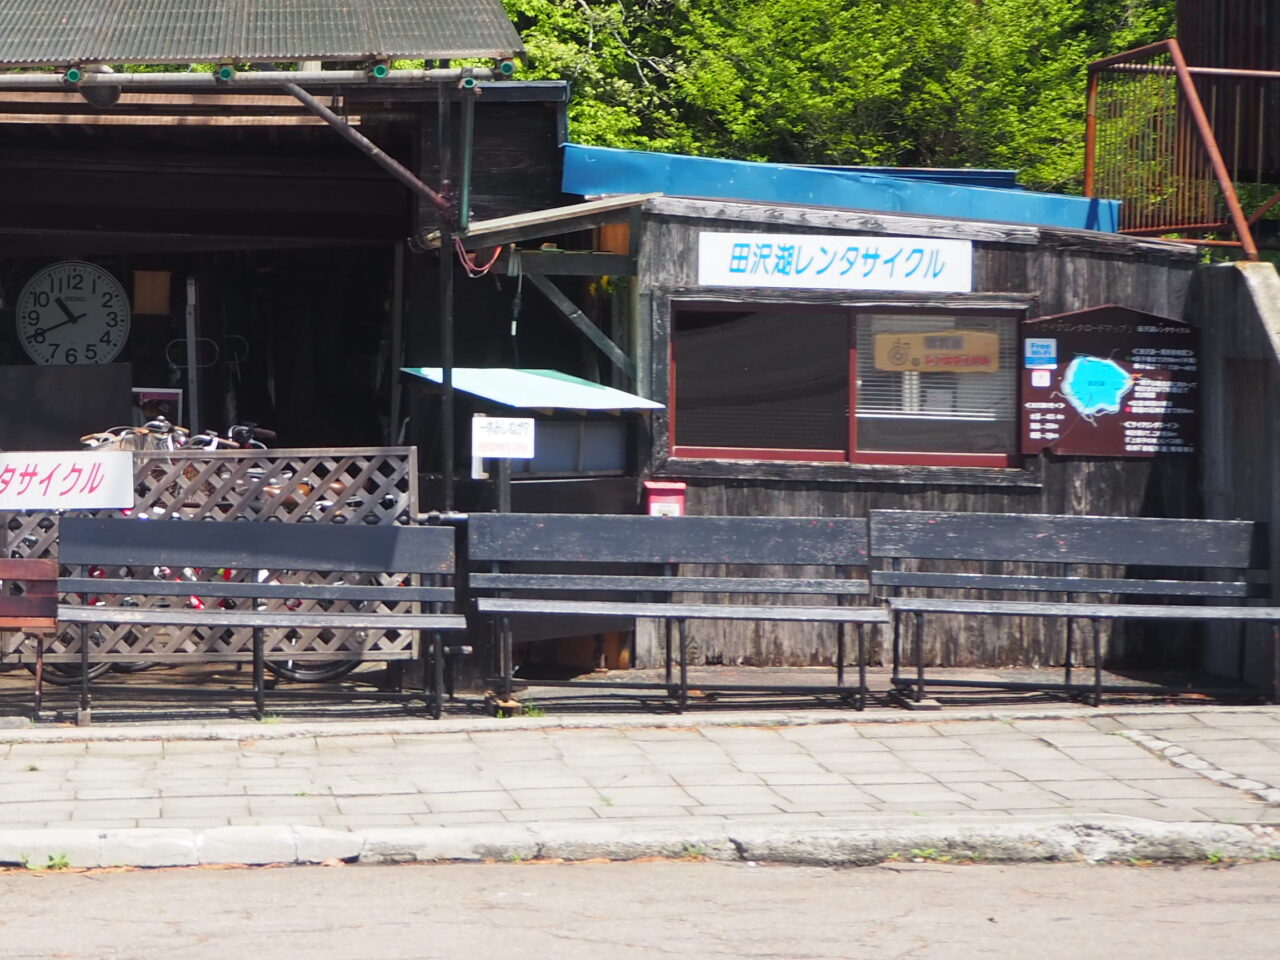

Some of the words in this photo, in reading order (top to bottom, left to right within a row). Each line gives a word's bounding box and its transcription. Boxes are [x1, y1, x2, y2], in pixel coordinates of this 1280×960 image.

[729, 242, 946, 280] 田沢湖レンタサイクル
[50, 277, 63, 293] 11
[67, 274, 84, 290] 12
[92, 278, 96, 294] 1
[32, 291, 50, 308] 10
[101, 292, 113, 308] 2
[27, 310, 40, 327] 9
[106, 311, 119, 328] 3
[33, 327, 46, 344] 8
[99, 330, 112, 346] 4
[48, 343, 61, 359] 7
[65, 348, 78, 364] 6
[85, 344, 97, 360] 5
